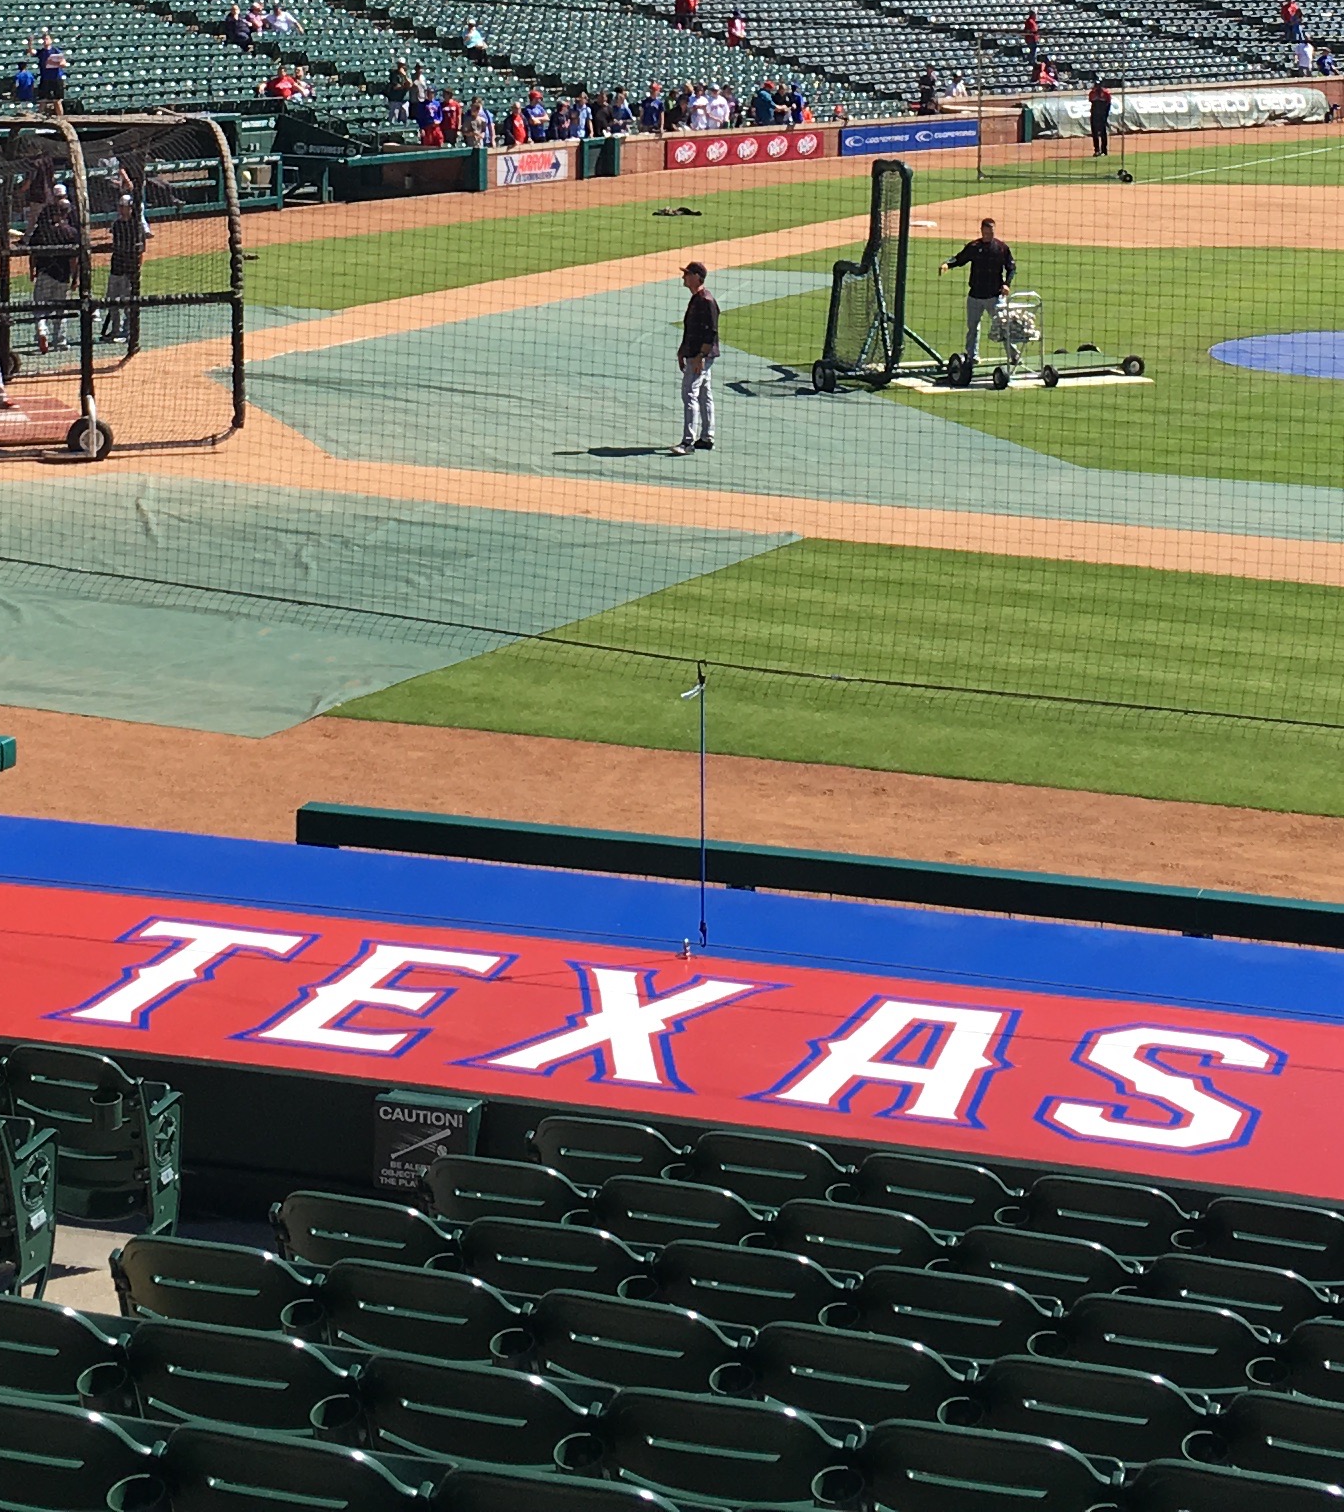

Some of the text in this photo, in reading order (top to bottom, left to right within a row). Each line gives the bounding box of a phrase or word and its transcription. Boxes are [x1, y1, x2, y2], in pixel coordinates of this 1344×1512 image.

[519, 152, 554, 173] ARROW
[51, 916, 1282, 1153] TEXAS
[379, 1106, 463, 1128] CAUTION!
[390, 1161, 402, 1169] BE
